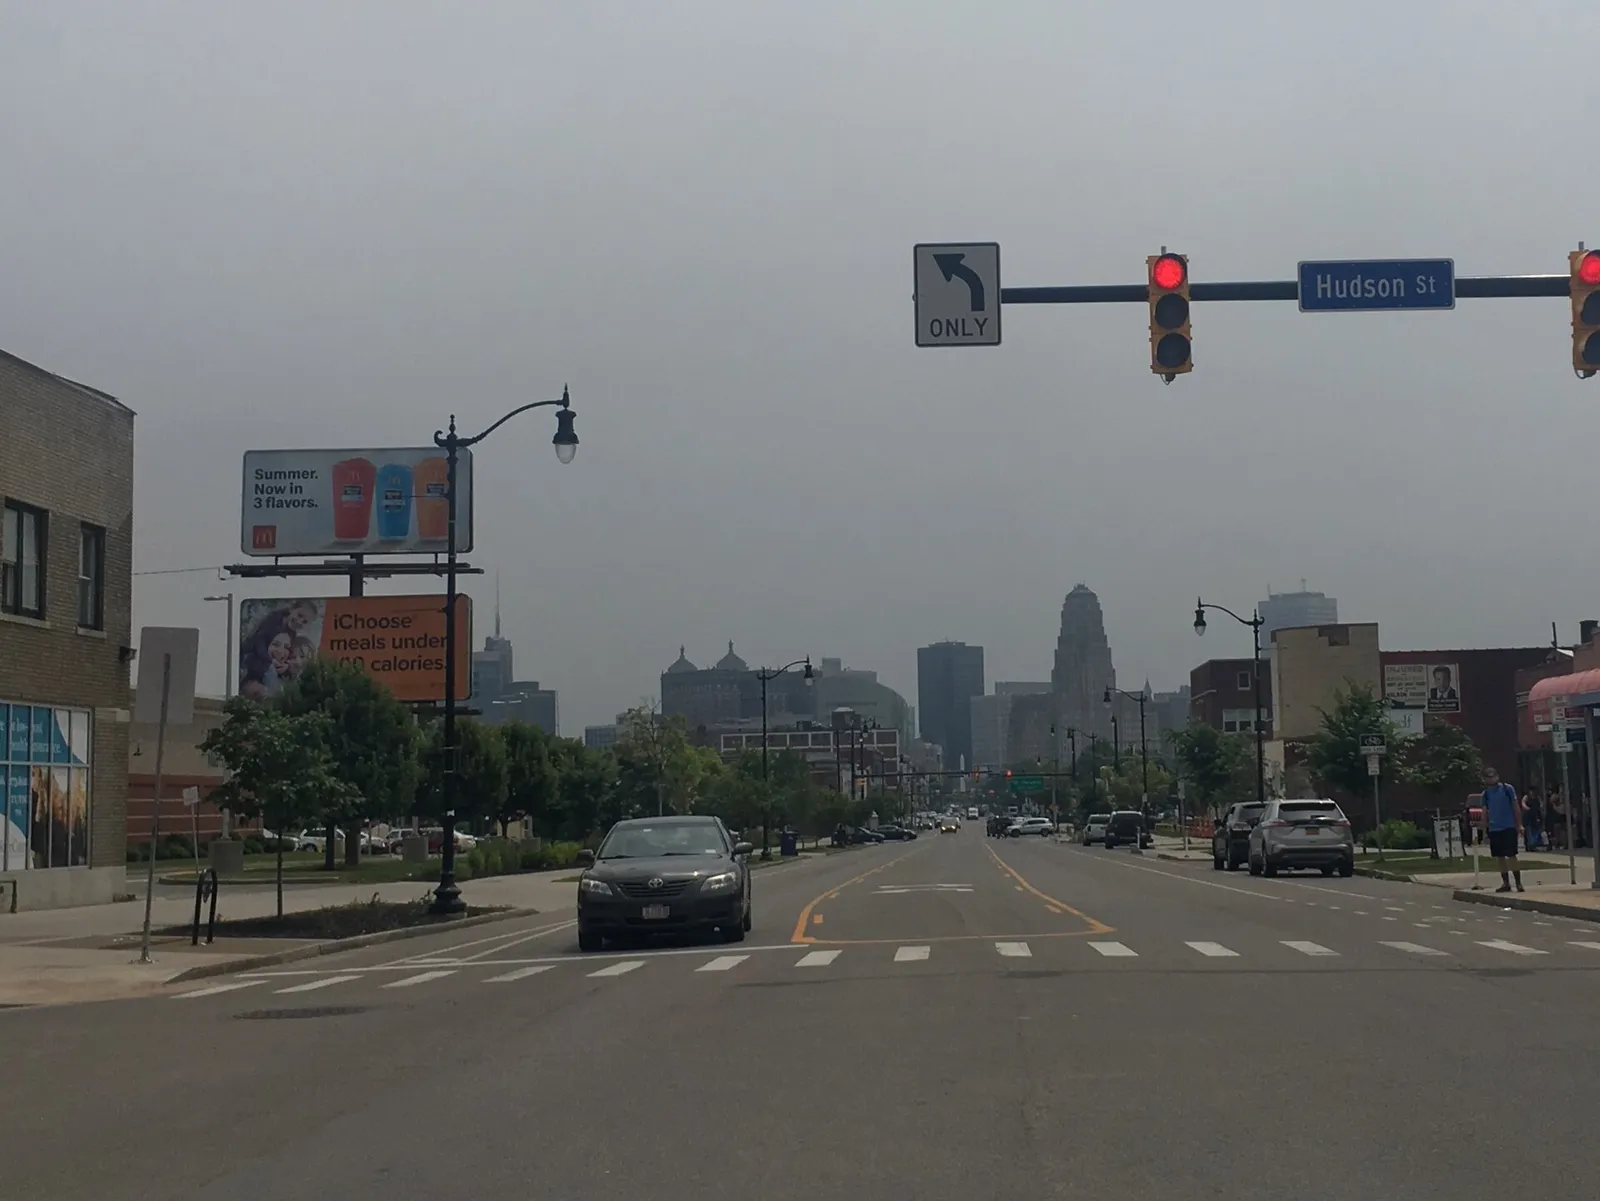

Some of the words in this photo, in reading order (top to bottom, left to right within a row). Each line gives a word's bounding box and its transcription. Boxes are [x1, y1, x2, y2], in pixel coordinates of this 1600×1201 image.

[1316, 274, 1405, 299] Hudson
[1415, 275, 1436, 294] St
[929, 318, 988, 337] ONLY
[254, 468, 318, 480] Summer.
[254, 483, 286, 495] Now
[290, 482, 303, 494] in
[253, 497, 262, 509] 3
[266, 496, 318, 508] flavors.
[330, 634, 386, 650] meals
[391, 633, 448, 649] under
